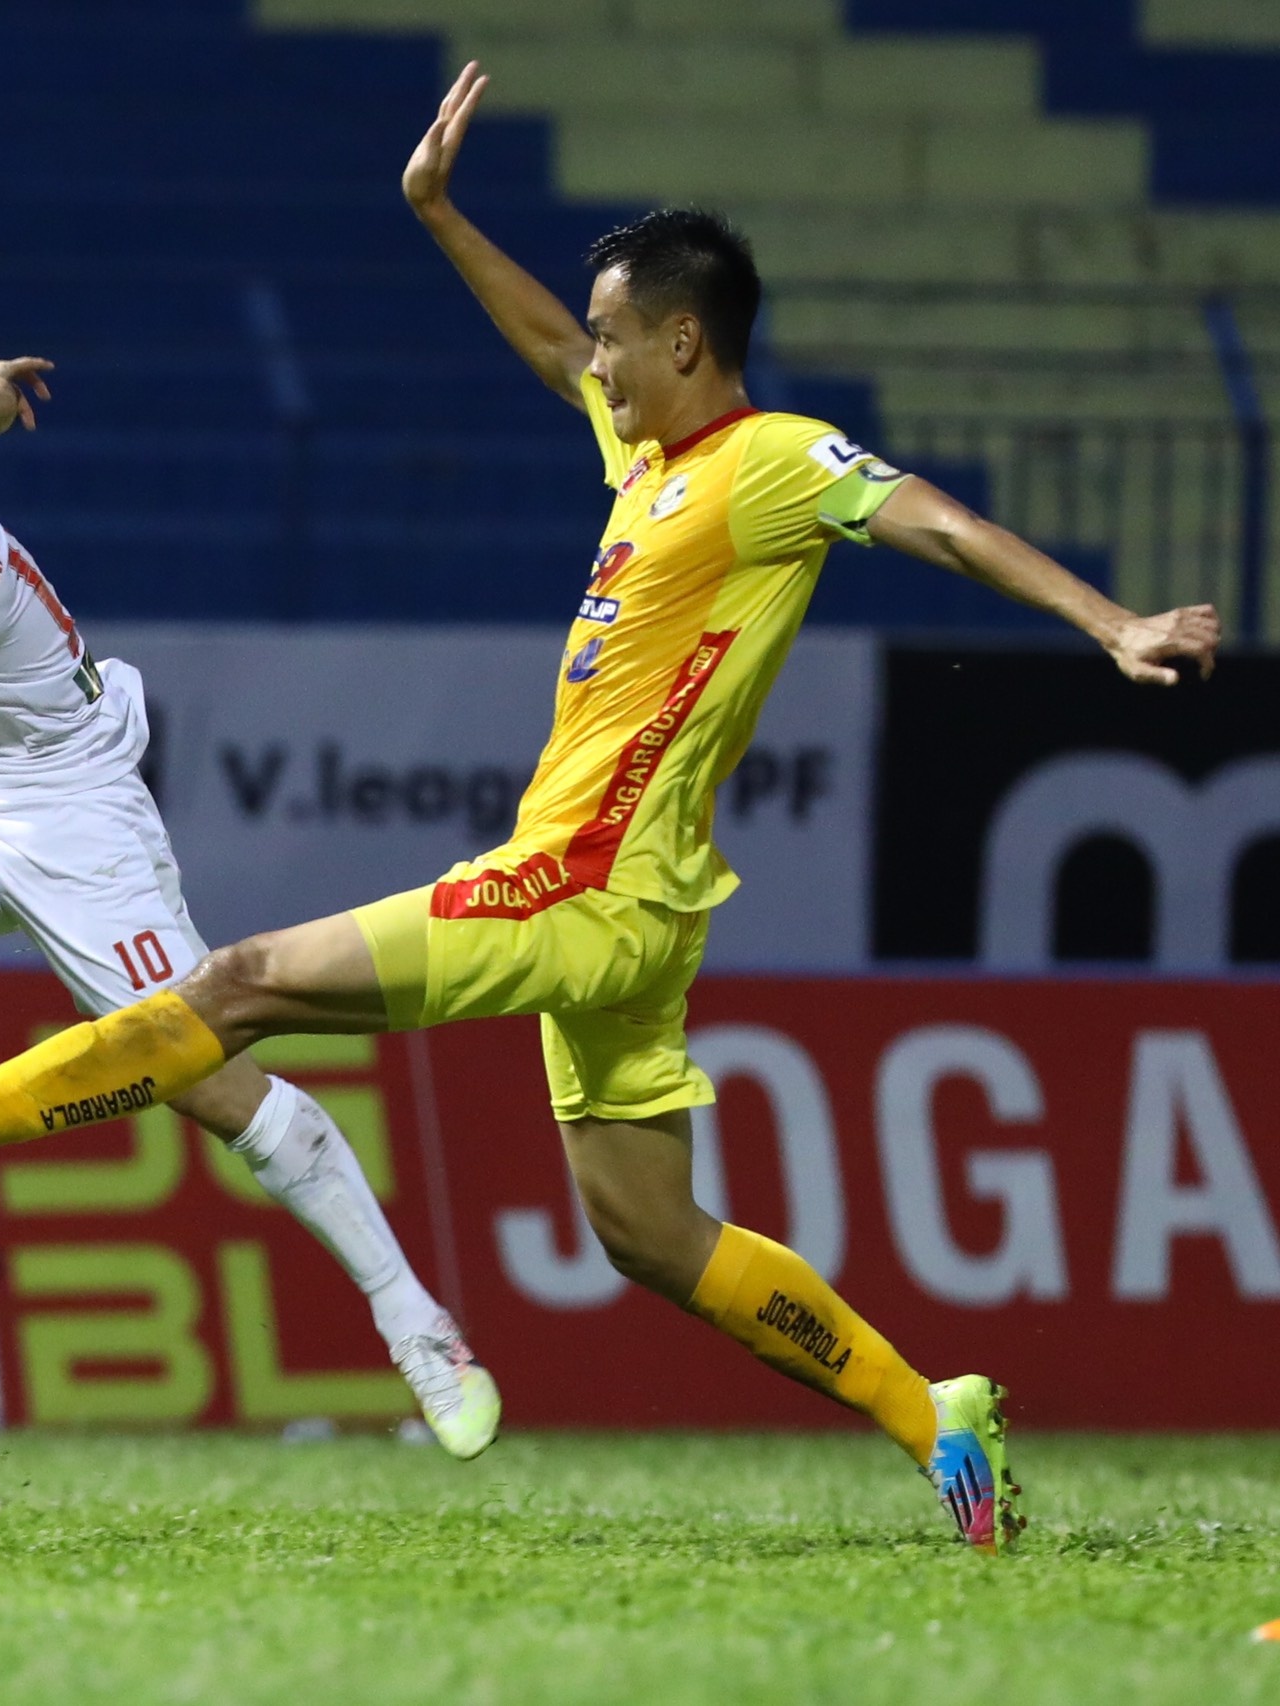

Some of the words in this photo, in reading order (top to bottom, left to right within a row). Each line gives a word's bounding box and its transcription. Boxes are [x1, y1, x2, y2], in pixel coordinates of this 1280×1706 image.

[220, 740, 526, 846] V.leag
[730, 745, 830, 826] PF
[112, 930, 174, 991] 10
[40, 1076, 156, 1131] JOGARBOLA
[8, 1244, 417, 1422] BL
[757, 1289, 852, 1375] JOGARBOLA
